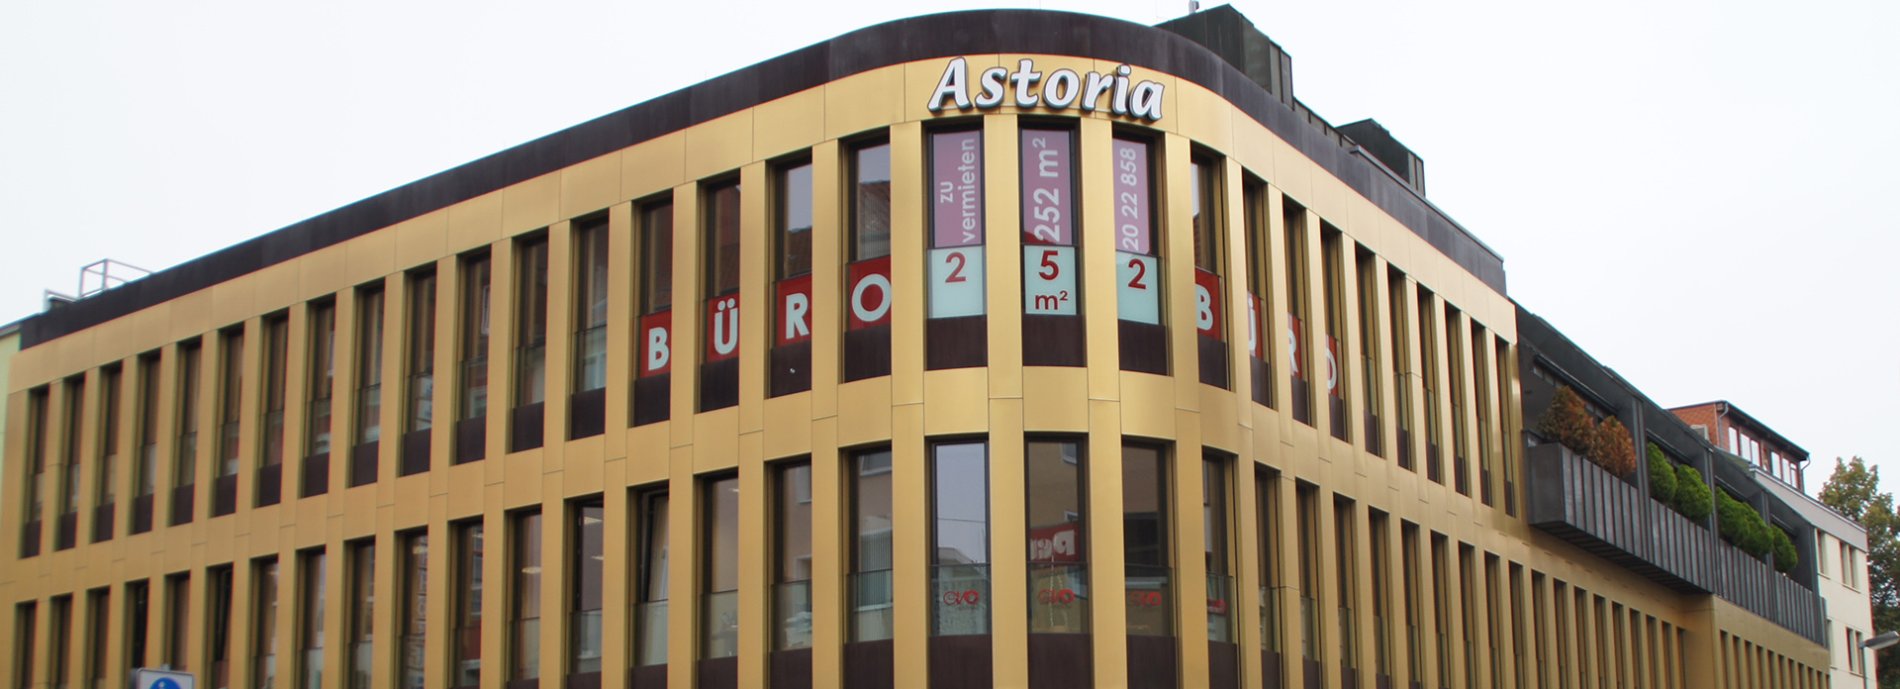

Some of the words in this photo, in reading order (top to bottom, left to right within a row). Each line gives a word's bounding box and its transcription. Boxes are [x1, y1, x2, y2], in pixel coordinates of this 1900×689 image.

[927, 56, 1166, 121] Astoria
[1032, 137, 1059, 177] m²
[1119, 147, 1137, 187] 858
[940, 181, 954, 204] zu
[957, 138, 977, 244] vermieten
[1121, 191, 1138, 219] 22
[1033, 188, 1061, 242] 252
[1122, 223, 1139, 252] 20
[1034, 290, 1068, 310] m²
